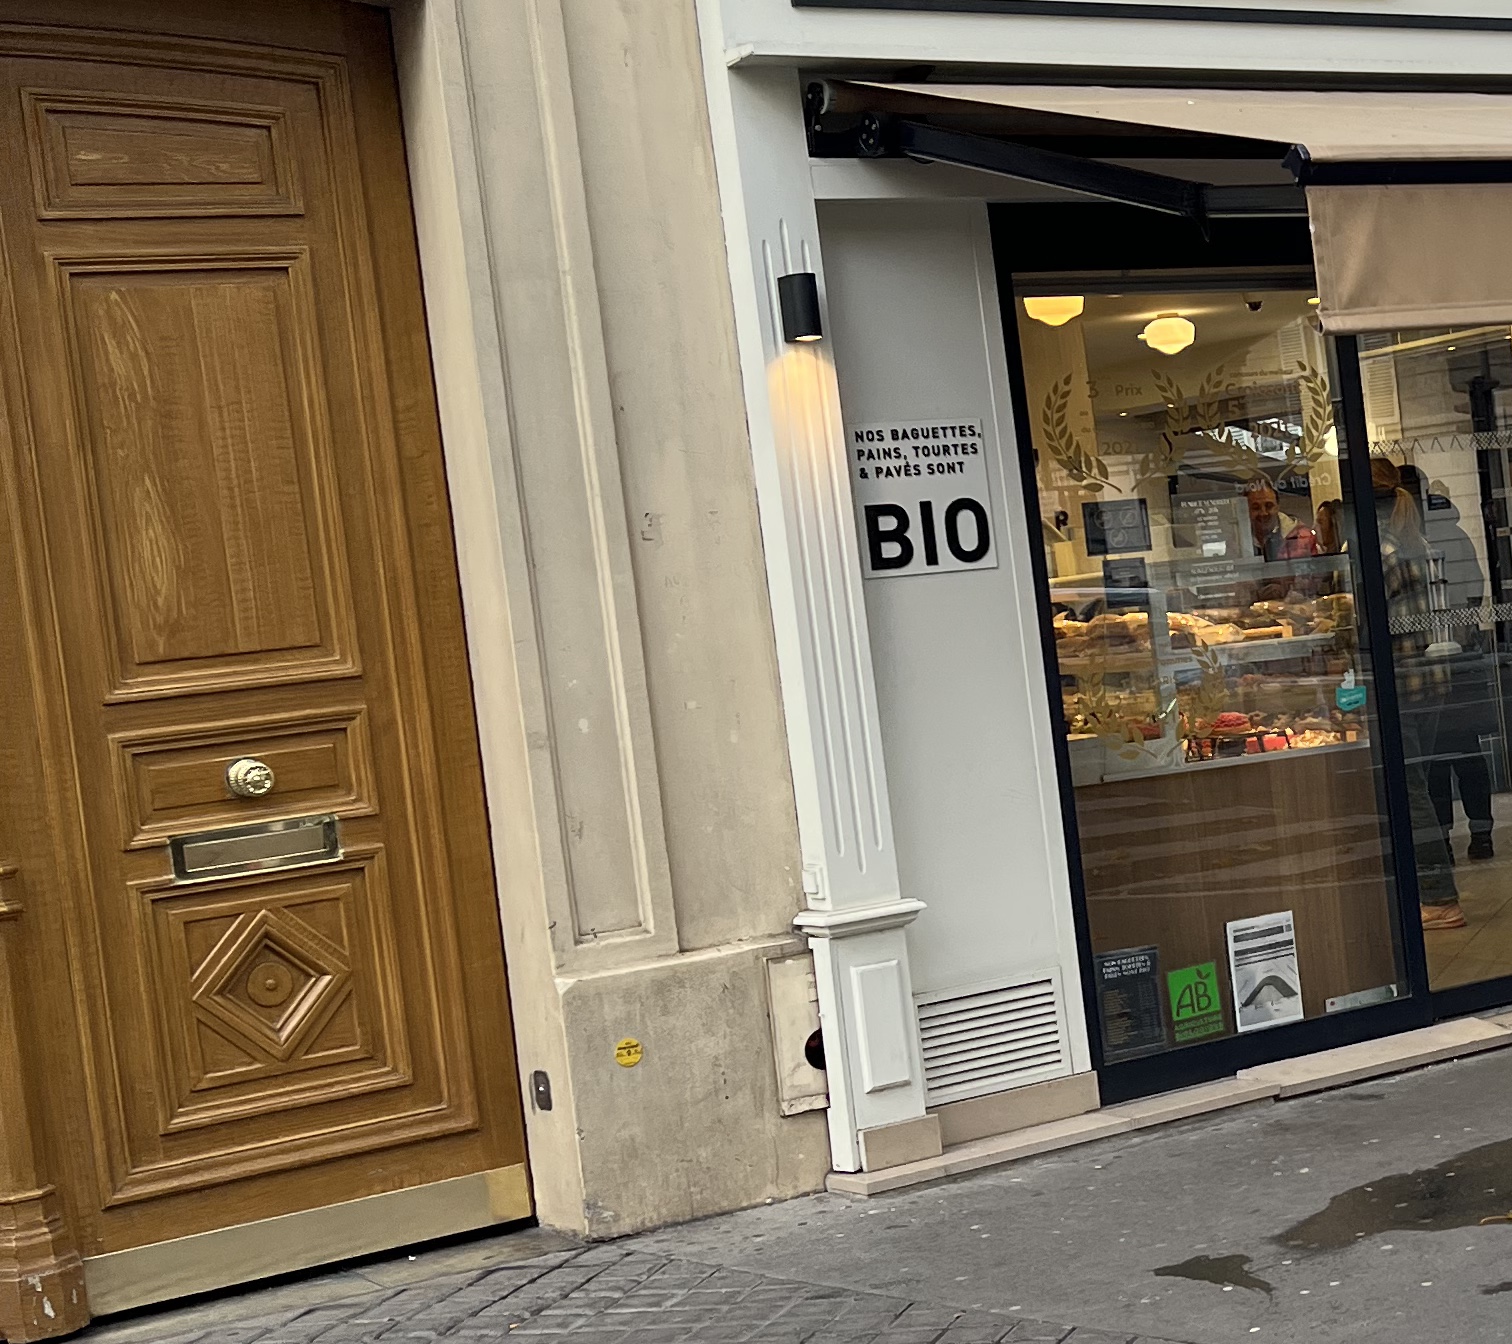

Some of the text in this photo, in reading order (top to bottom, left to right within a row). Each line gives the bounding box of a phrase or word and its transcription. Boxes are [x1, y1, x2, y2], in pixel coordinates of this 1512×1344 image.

[1114, 383, 1143, 397] Prix
[854, 425, 982, 443] NOS BAGUETTES,
[857, 442, 979, 461] PAINS, TOURTES
[859, 467, 870, 479] &
[927, 461, 965, 475] SONT
[863, 496, 991, 571] BIO
[1176, 981, 1212, 1017] AB
